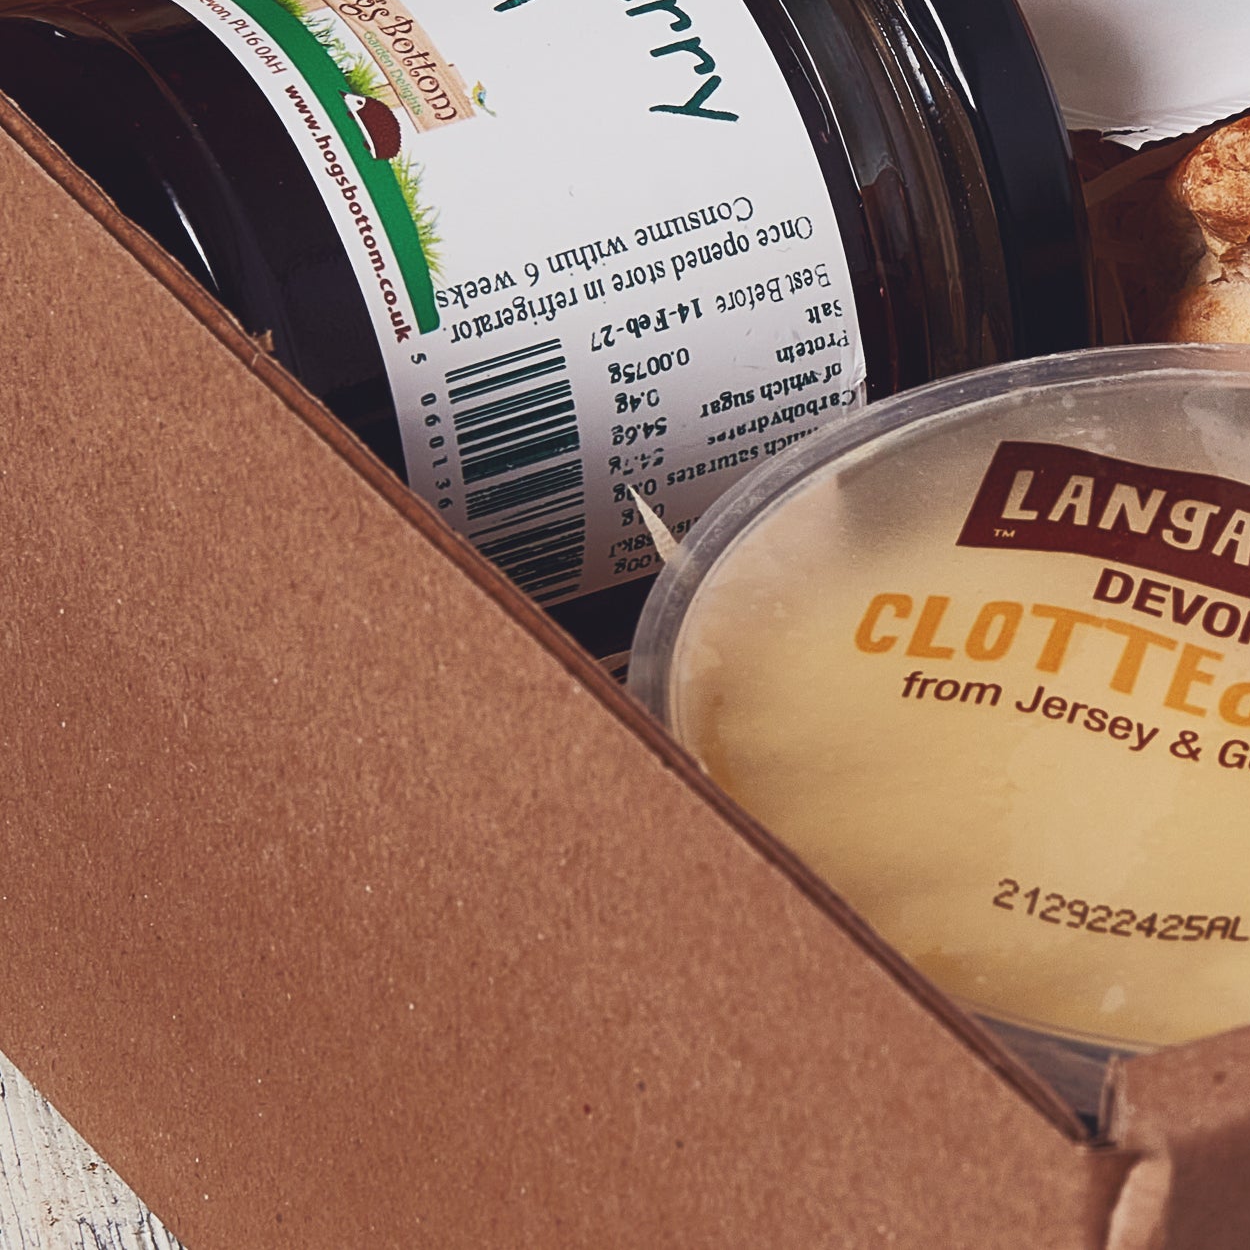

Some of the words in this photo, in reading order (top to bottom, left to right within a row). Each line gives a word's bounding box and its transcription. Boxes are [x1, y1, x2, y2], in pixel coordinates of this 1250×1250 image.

[363, 30, 395, 68] Garden
[389, 69, 424, 116] Delights
[378, 15, 457, 121] Bottom
[228, 18, 264, 47] PL16
[284, 84, 412, 343] www.hogsbottom.co.uk
[635, 196, 754, 247] Consume
[758, 215, 814, 247] Once
[547, 235, 629, 276] within
[674, 231, 751, 281] opened
[436, 270, 518, 309] weeks
[524, 262, 539, 287] 6
[583, 279, 606, 305] in
[612, 260, 666, 292] store
[789, 263, 832, 290] Best
[715, 279, 783, 313] Before
[805, 299, 843, 324] Salt
[443, 286, 579, 344] refrigerator.
[591, 298, 703, 351] 14-Feb-27
[775, 330, 850, 363] Protein
[608, 347, 690, 384] 0.0075g
[824, 362, 842, 378] of
[614, 388, 660, 415] 0.4g
[760, 368, 821, 401] which
[700, 388, 755, 419] sugar
[611, 416, 668, 446] 54.6g
[667, 444, 759, 486] saturates
[901, 671, 1003, 707] from
[1015, 686, 1159, 751] Jersey
[1168, 730, 1202, 762] &
[992, 878, 1250, 942] 212922425AL
